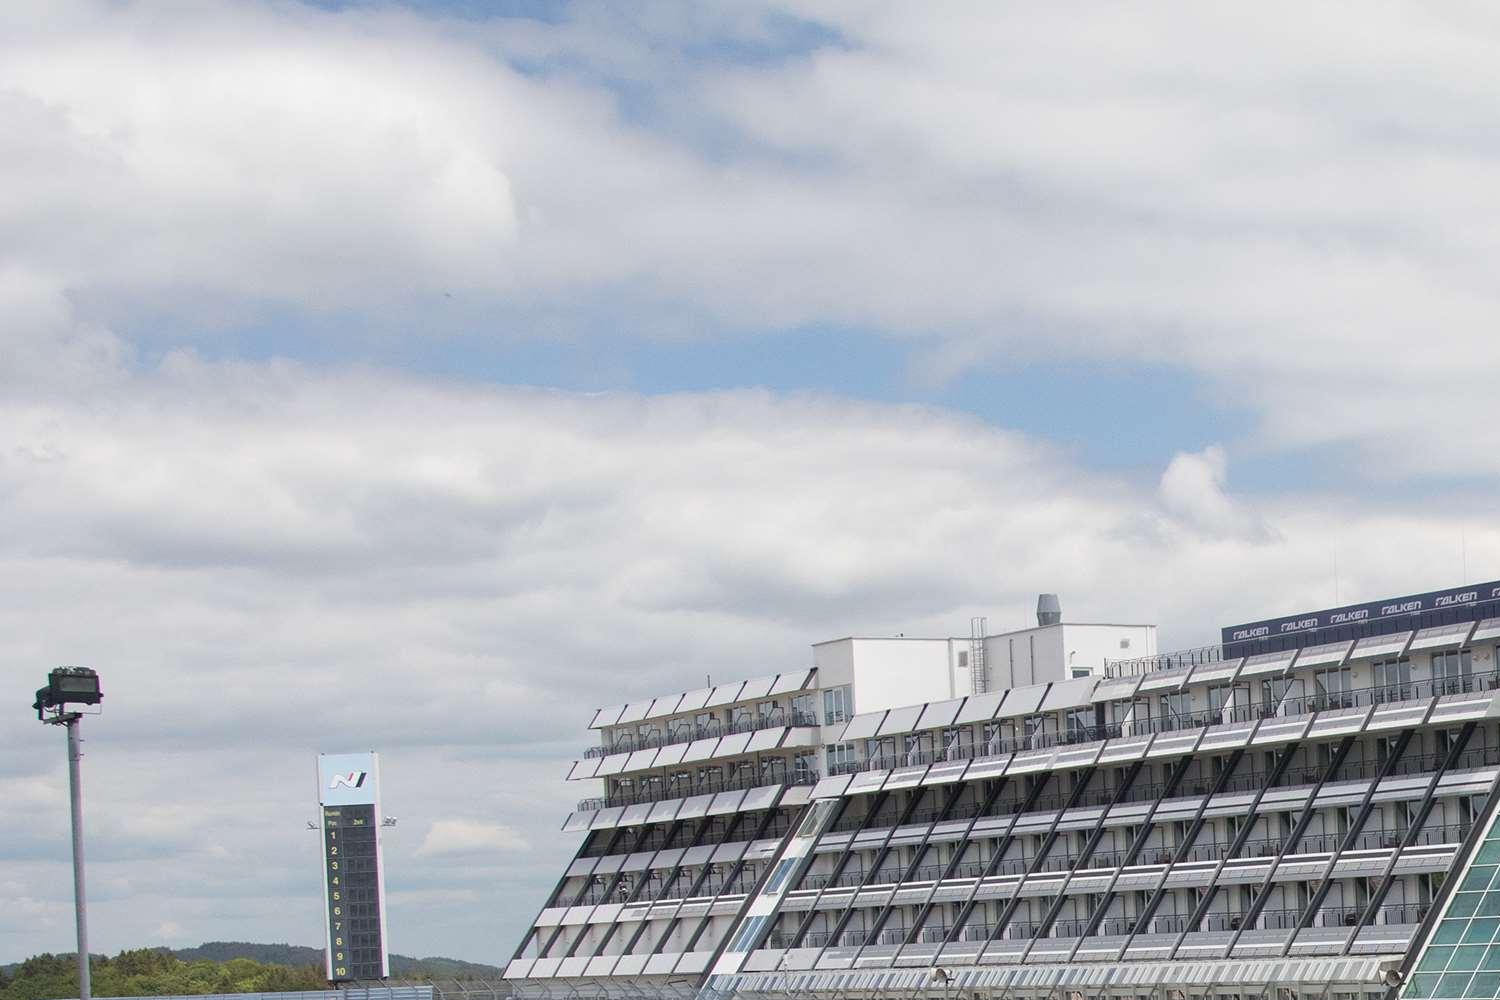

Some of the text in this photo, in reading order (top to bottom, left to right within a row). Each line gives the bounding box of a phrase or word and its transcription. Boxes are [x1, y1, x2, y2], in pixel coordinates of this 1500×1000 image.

[1434, 591, 1478, 607] FALKEN
[1381, 600, 1422, 615] FALKEN
[1330, 609, 1369, 624] FALKEN
[1281, 618, 1318, 632] FALKEN
[1233, 626, 1269, 640] FALKEN
[330, 831, 337, 840] 1
[331, 846, 338, 855] 2
[332, 861, 339, 871] 3
[332, 877, 339, 885] 4
[333, 892, 341, 900] 5
[334, 907, 341, 916] 6
[335, 922, 341, 930] 7
[335, 937, 343, 946] 8
[336, 952, 343, 961] 9
[335, 967, 346, 976] 10
